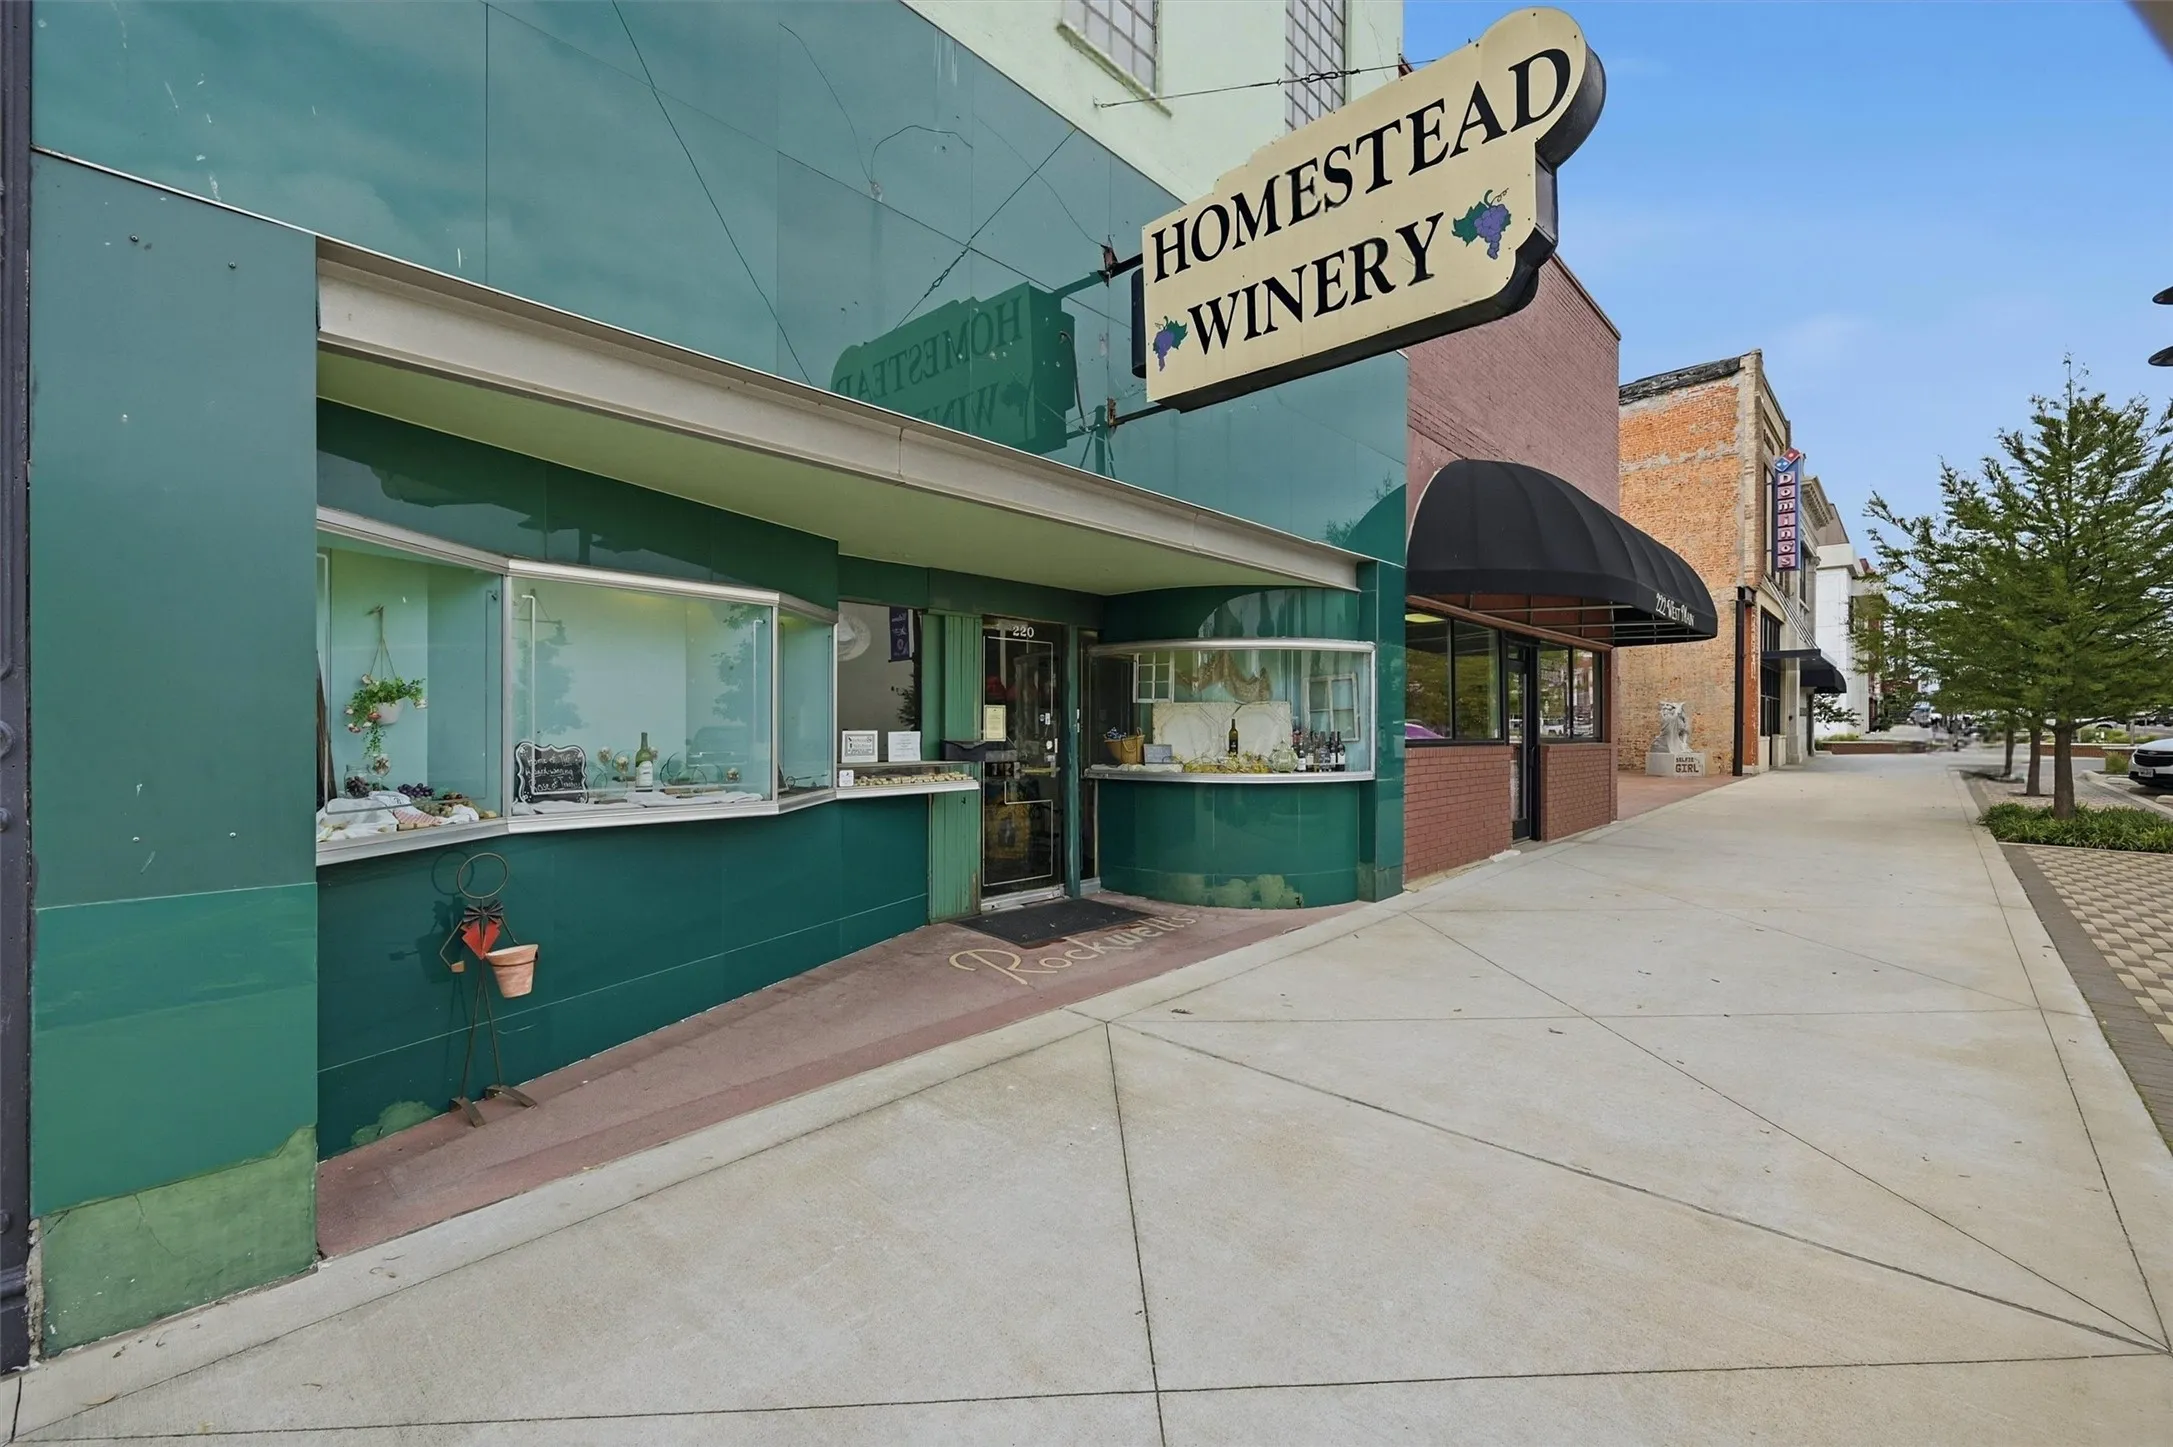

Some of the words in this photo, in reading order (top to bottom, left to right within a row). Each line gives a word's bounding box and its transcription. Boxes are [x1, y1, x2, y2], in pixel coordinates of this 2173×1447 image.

[1151, 48, 1572, 284] HOMESTEAD
[1187, 211, 1445, 355] WINERY
[1012, 625, 1035, 638] 220
[1675, 763, 1699, 773] GIRL
